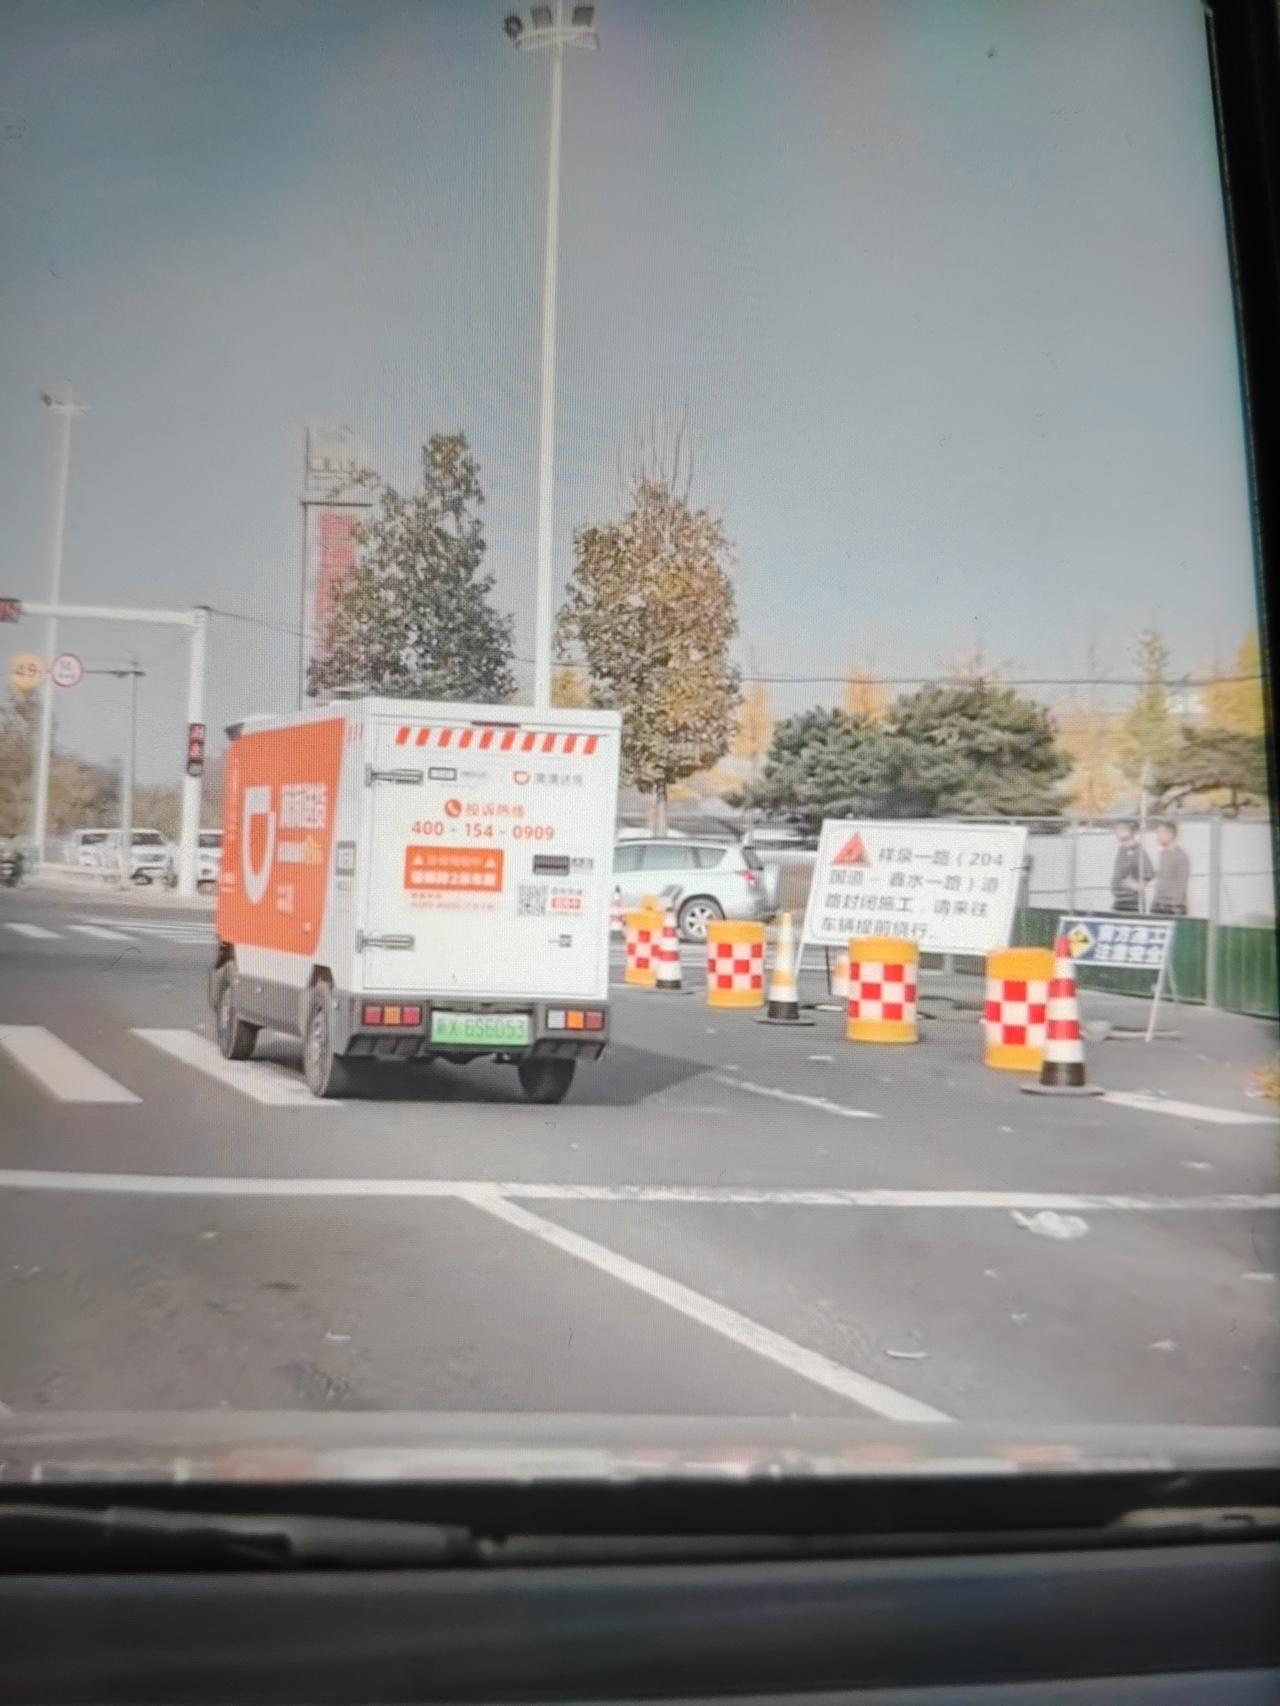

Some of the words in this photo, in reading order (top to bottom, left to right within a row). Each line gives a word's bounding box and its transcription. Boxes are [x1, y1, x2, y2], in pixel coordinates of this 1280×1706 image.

[412, 820, 444, 836] 400
[464, 822, 494, 838] 154
[512, 824, 555, 841] 0909
